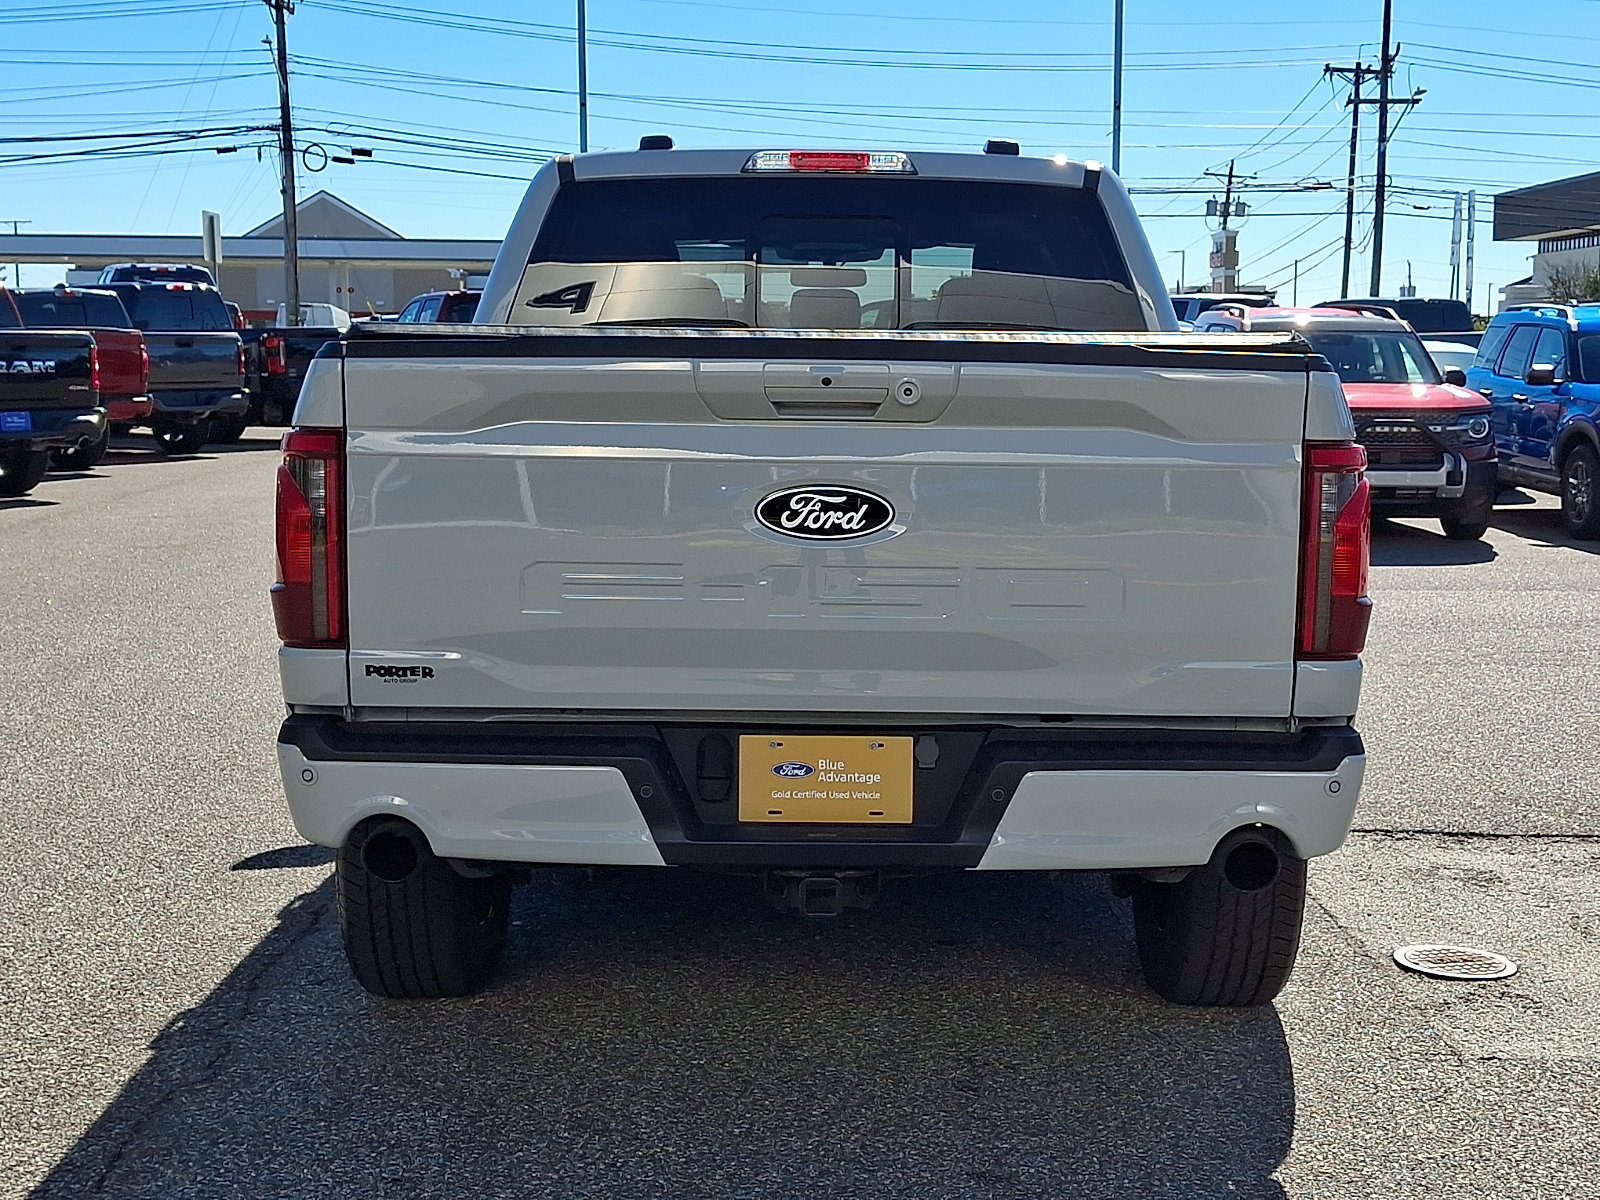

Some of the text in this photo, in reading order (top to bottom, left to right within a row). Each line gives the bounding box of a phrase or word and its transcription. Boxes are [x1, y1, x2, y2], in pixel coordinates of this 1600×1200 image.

[780, 493, 869, 529] Ford
[365, 664, 435, 679] PORTER
[779, 761, 808, 777] Ford
[818, 759, 845, 771] Blue
[817, 771, 881, 785] Advantage
[771, 790, 881, 800] Gold Certified Used Vehicle
